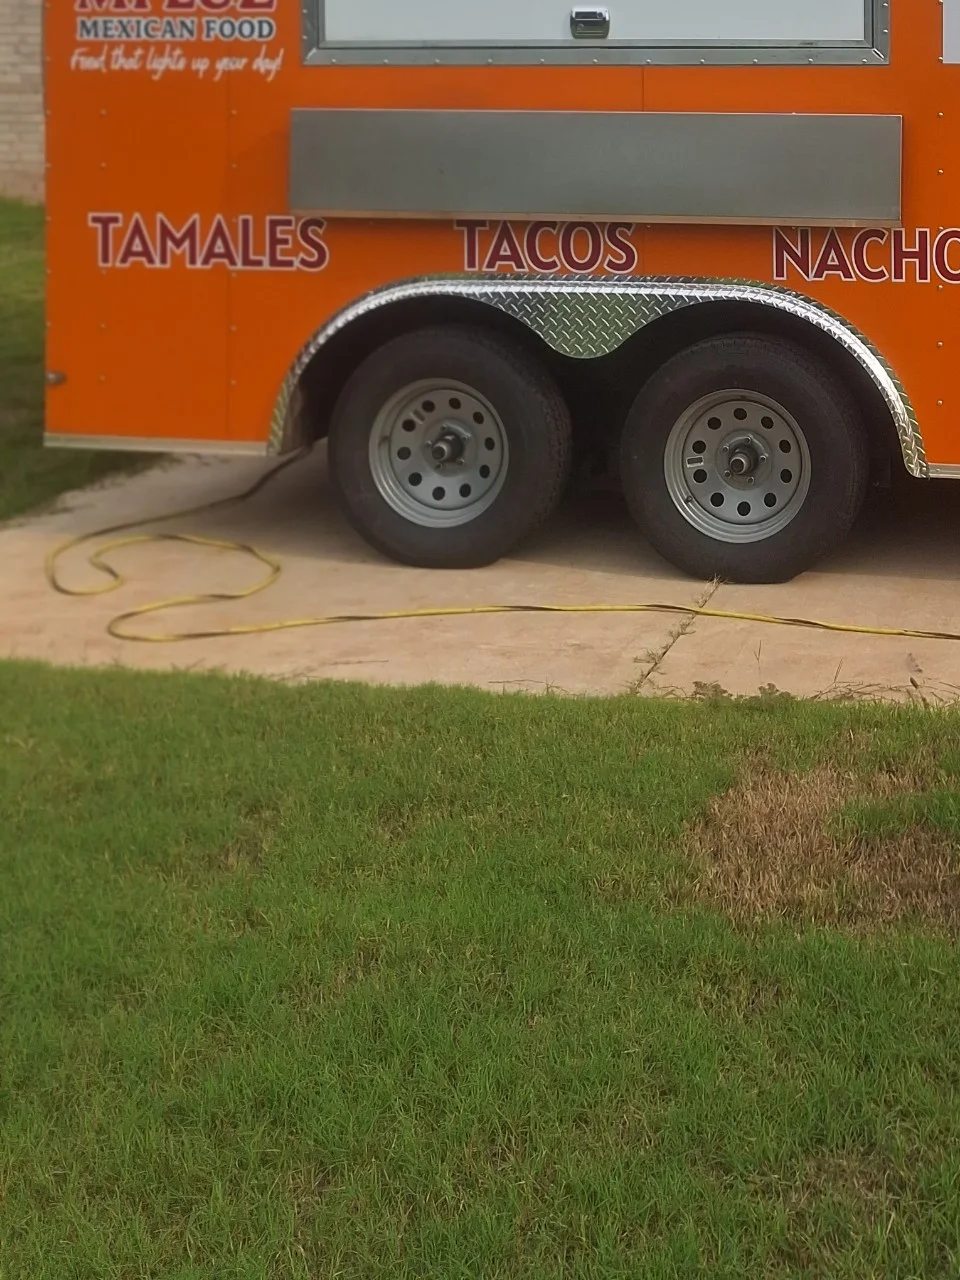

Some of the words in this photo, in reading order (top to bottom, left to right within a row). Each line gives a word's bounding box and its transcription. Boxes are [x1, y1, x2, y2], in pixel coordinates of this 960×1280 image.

[77, 17, 198, 41] MEXICAN
[202, 17, 276, 41] FOOD
[111, 44, 144, 71] that
[145, 43, 187, 81] lights
[190, 54, 210, 79] up
[88, 213, 330, 271] TAMALES
[456, 220, 639, 274] TACOS
